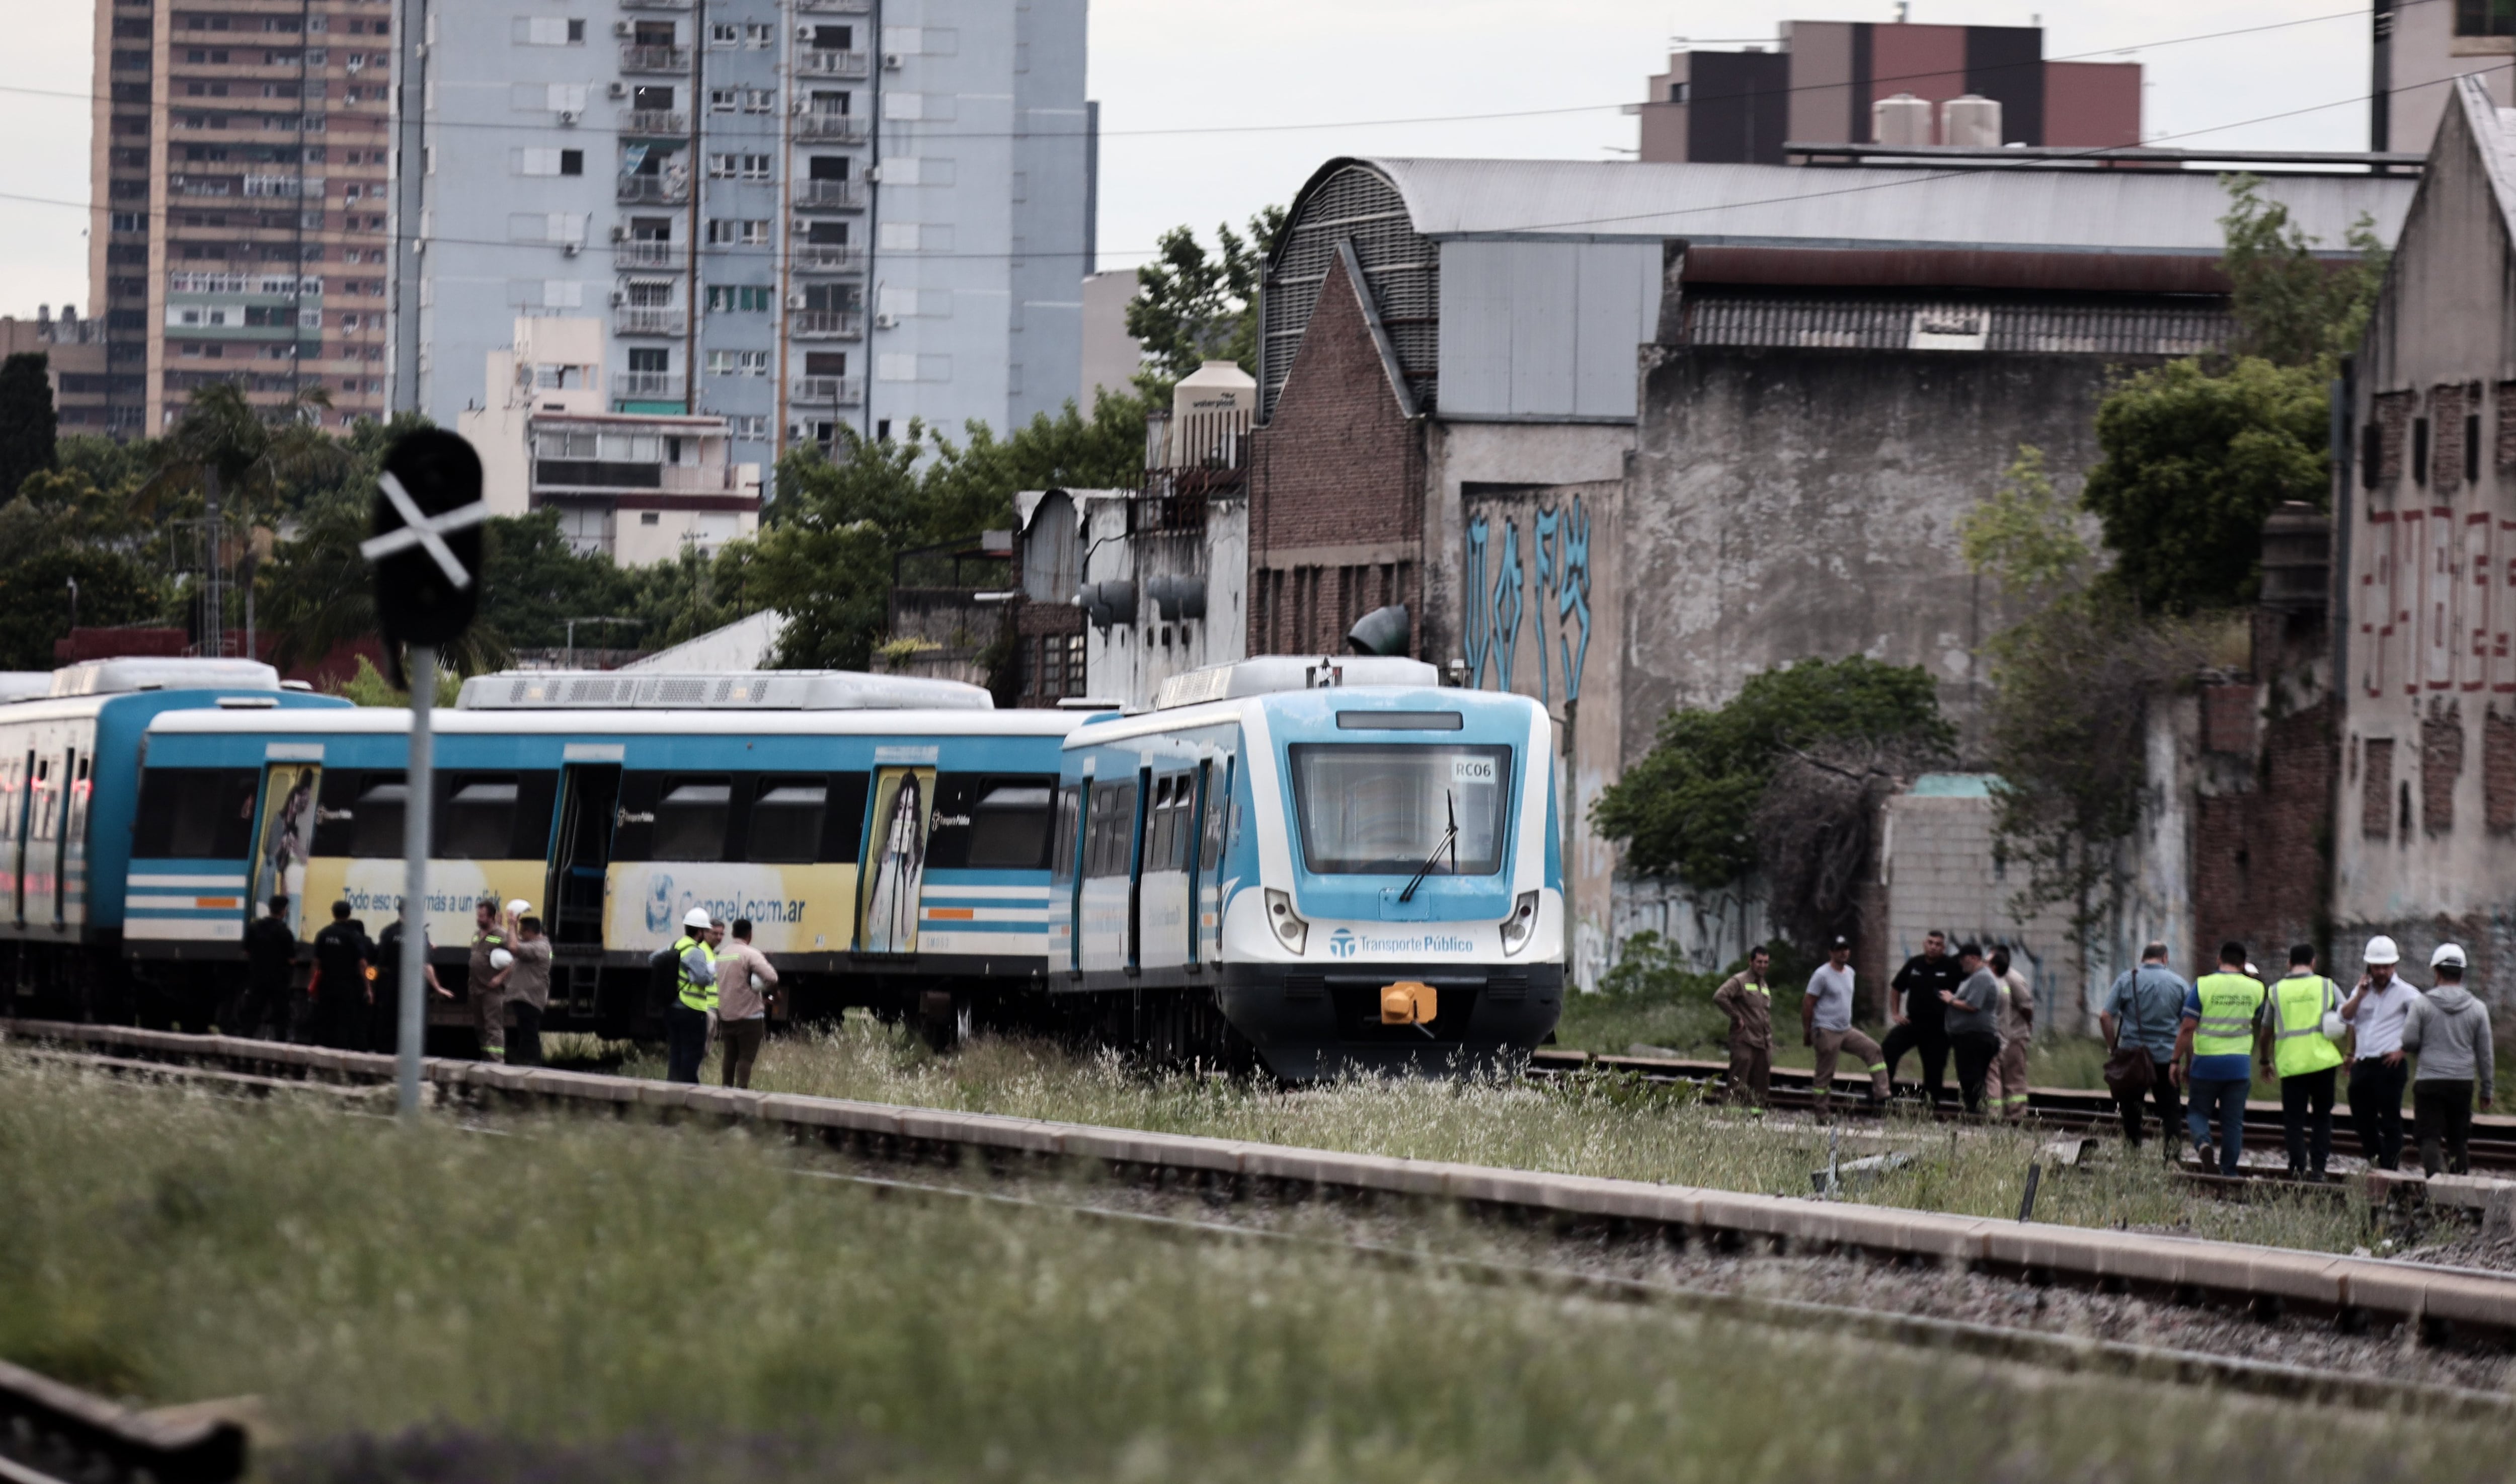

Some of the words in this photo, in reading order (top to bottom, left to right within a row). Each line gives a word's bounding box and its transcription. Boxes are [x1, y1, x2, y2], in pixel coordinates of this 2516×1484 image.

[1456, 763, 1491, 777] RC06
[458, 895, 473, 912] un
[1360, 935, 1422, 954] Transporte
[1424, 935, 1473, 952] Público
